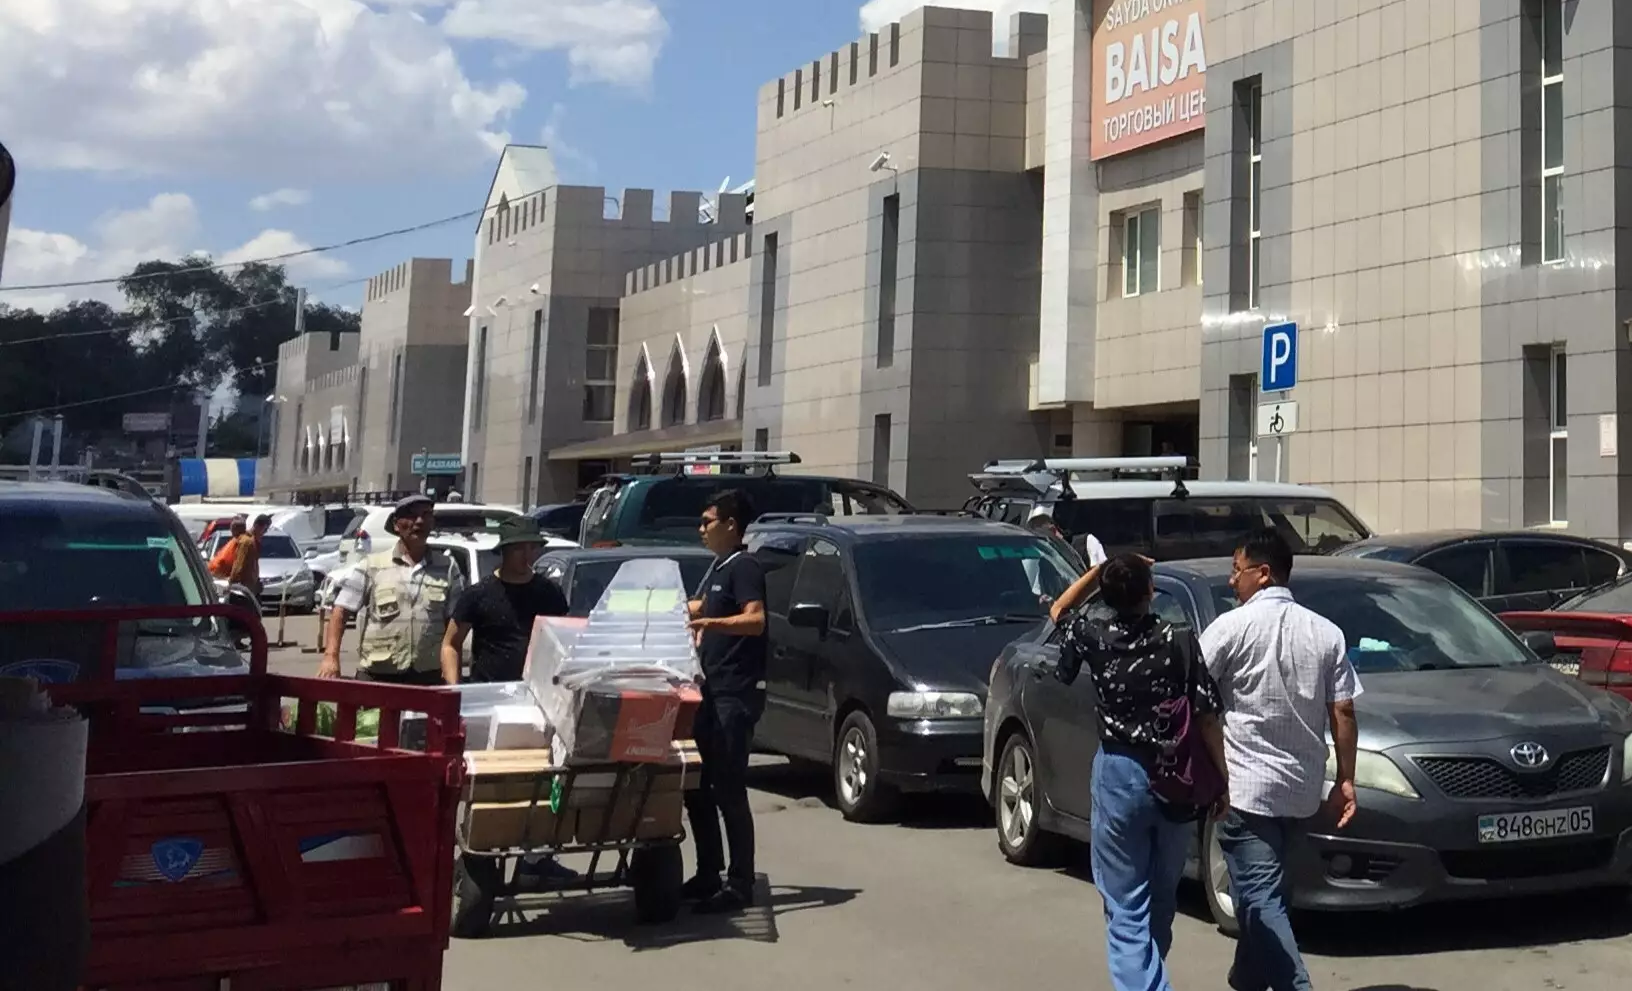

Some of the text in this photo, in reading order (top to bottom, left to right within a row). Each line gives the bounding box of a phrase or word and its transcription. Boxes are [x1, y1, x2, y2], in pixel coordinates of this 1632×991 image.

[1105, 11, 1207, 106] BAISA
[1103, 94, 1176, 144] ТОРГОВЫЙ
[1270, 332, 1291, 384] P
[1480, 830, 1495, 840] KZ
